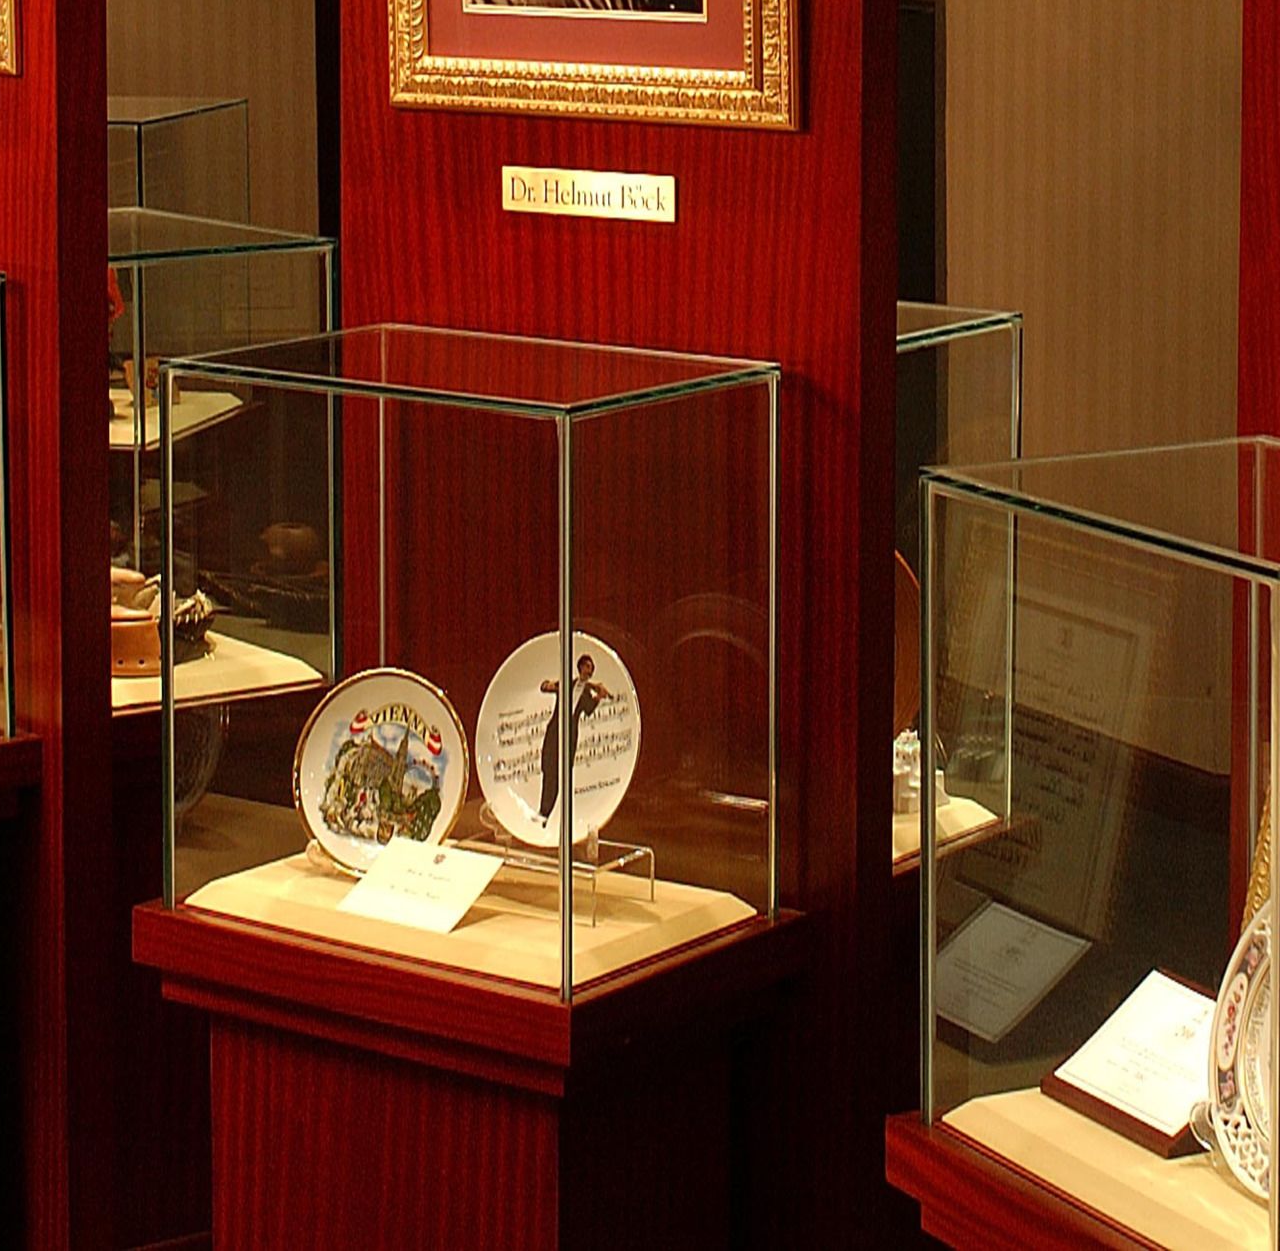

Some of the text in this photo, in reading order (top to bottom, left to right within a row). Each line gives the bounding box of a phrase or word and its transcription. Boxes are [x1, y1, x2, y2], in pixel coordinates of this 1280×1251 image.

[510, 175, 666, 212] Dr. Helmut Böck
[368, 703, 428, 742] VIENNA
